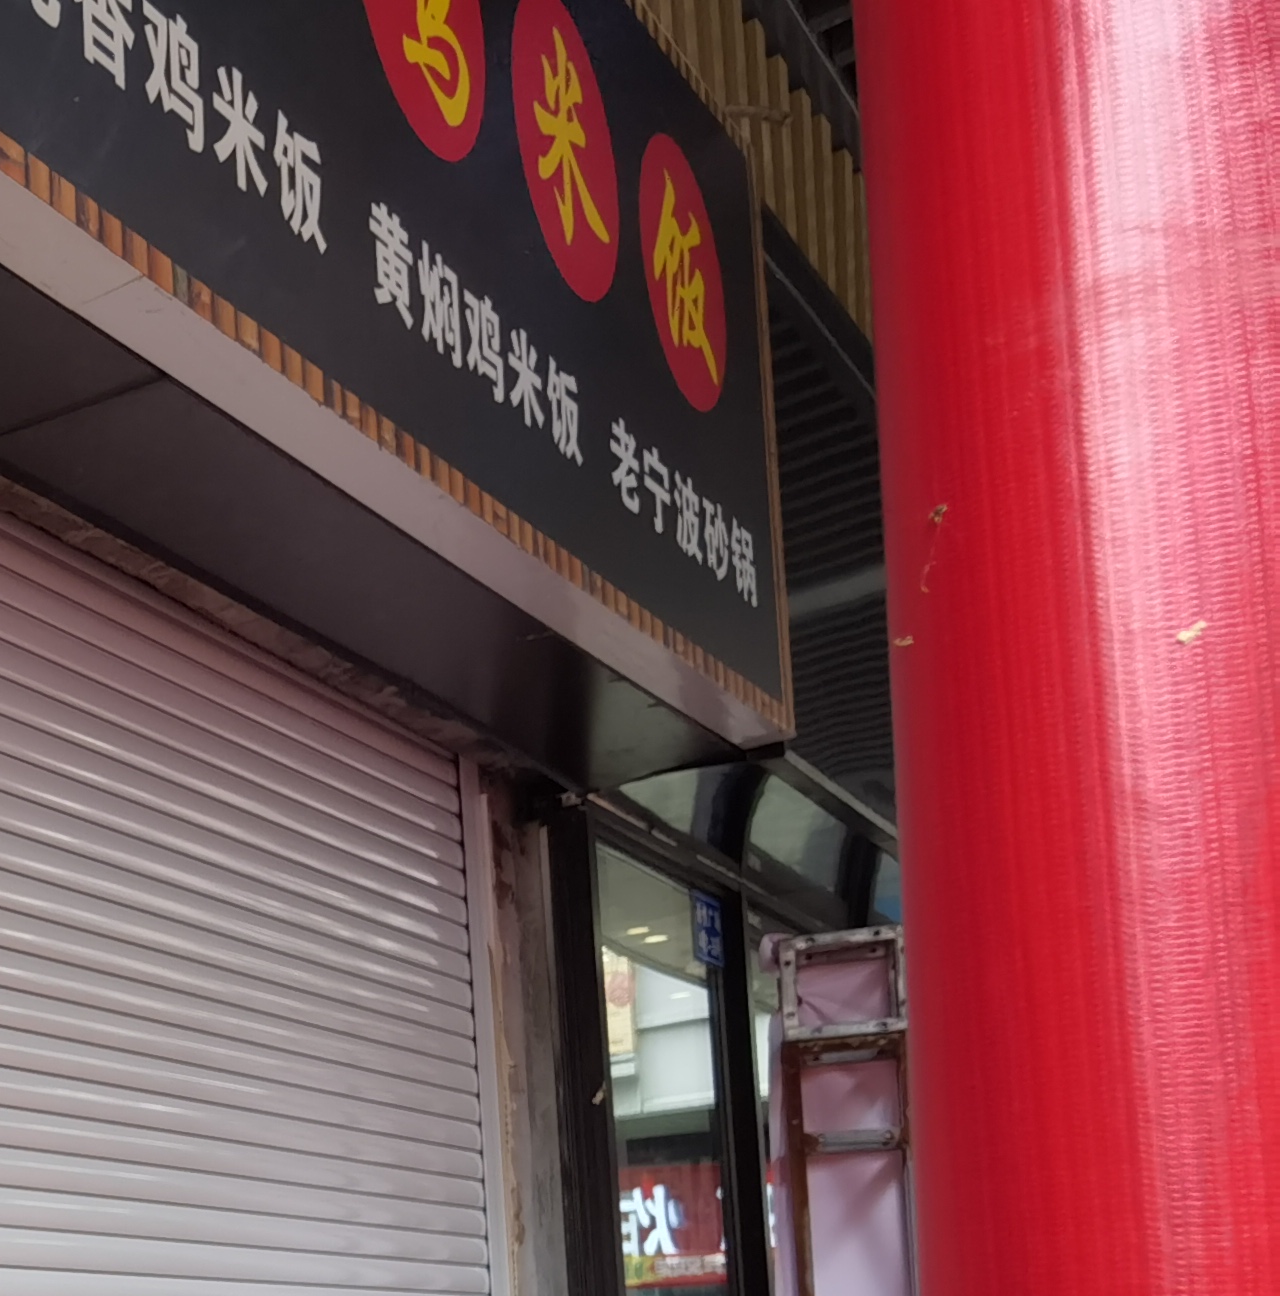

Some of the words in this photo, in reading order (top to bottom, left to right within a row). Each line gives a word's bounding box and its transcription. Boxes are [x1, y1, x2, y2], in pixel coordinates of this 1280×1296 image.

[31, 0, 328, 256] 香鸡米饭
[368, 202, 583, 467] 黄焖鸡米饭
[609, 416, 758, 608] 老宁波砂锅
